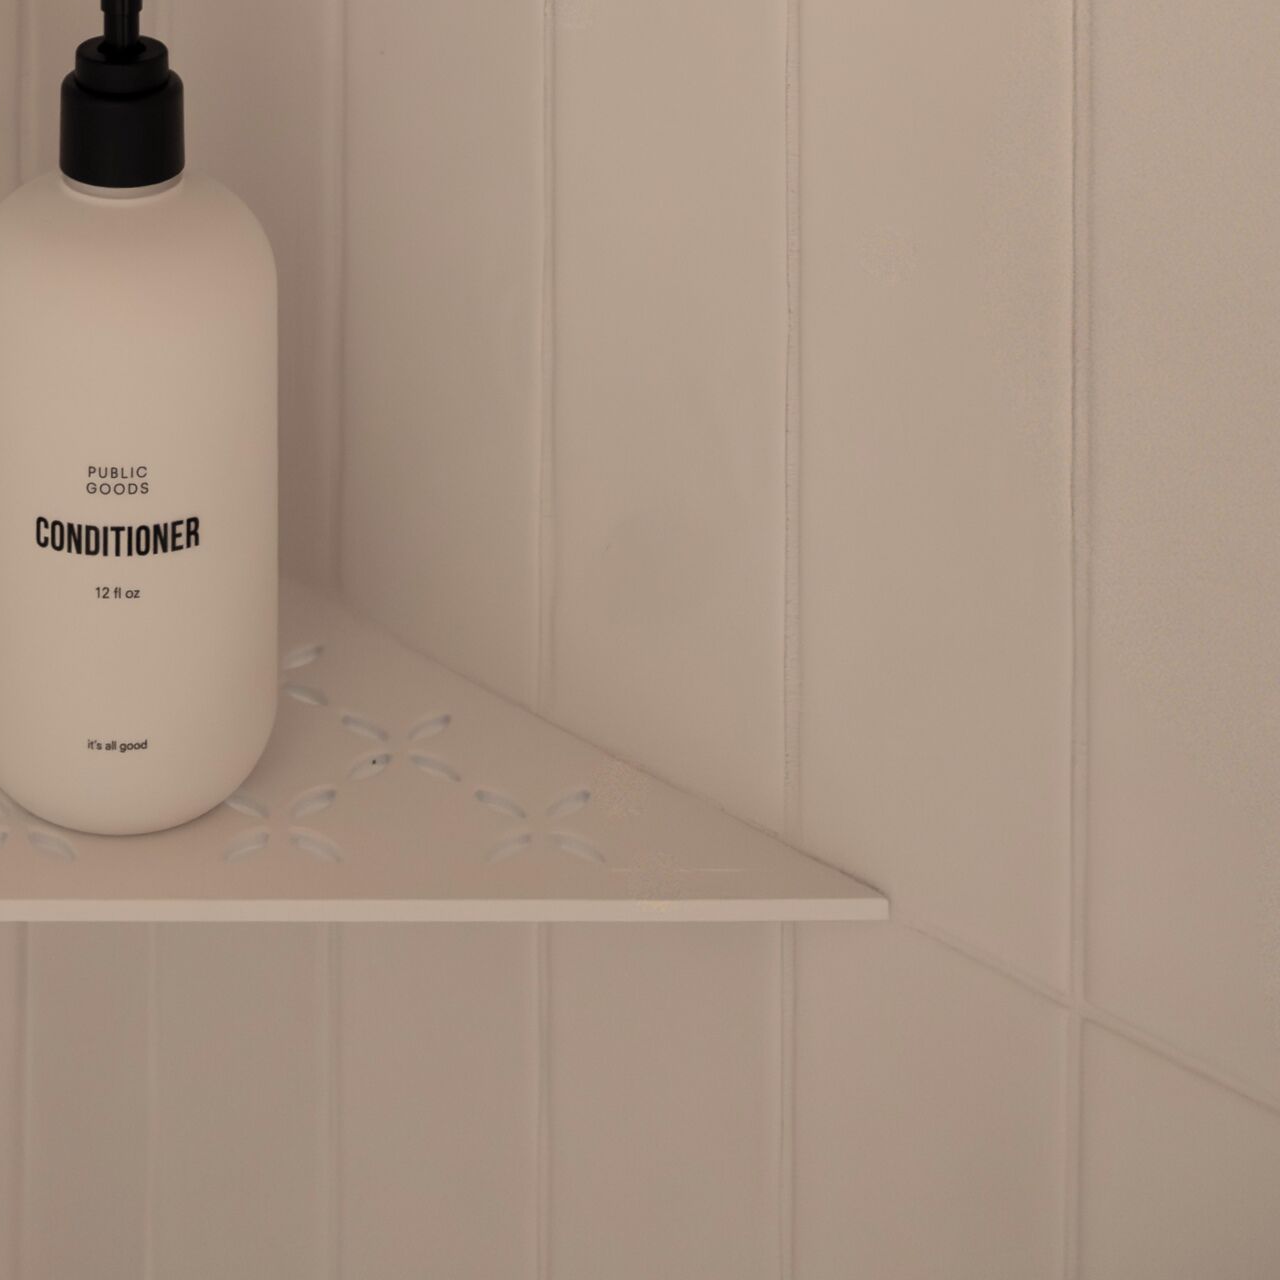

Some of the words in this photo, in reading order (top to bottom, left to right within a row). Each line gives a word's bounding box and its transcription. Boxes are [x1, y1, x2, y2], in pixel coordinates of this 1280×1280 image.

[88, 466, 148, 479] PUBLIC
[86, 482, 150, 495] GOODS
[35, 516, 200, 558] CONDITIONER
[95, 586, 110, 600] 12
[113, 586, 122, 600] fl
[125, 590, 140, 600] oz
[87, 739, 102, 750] it's
[105, 740, 117, 751] all
[119, 739, 148, 753] good
